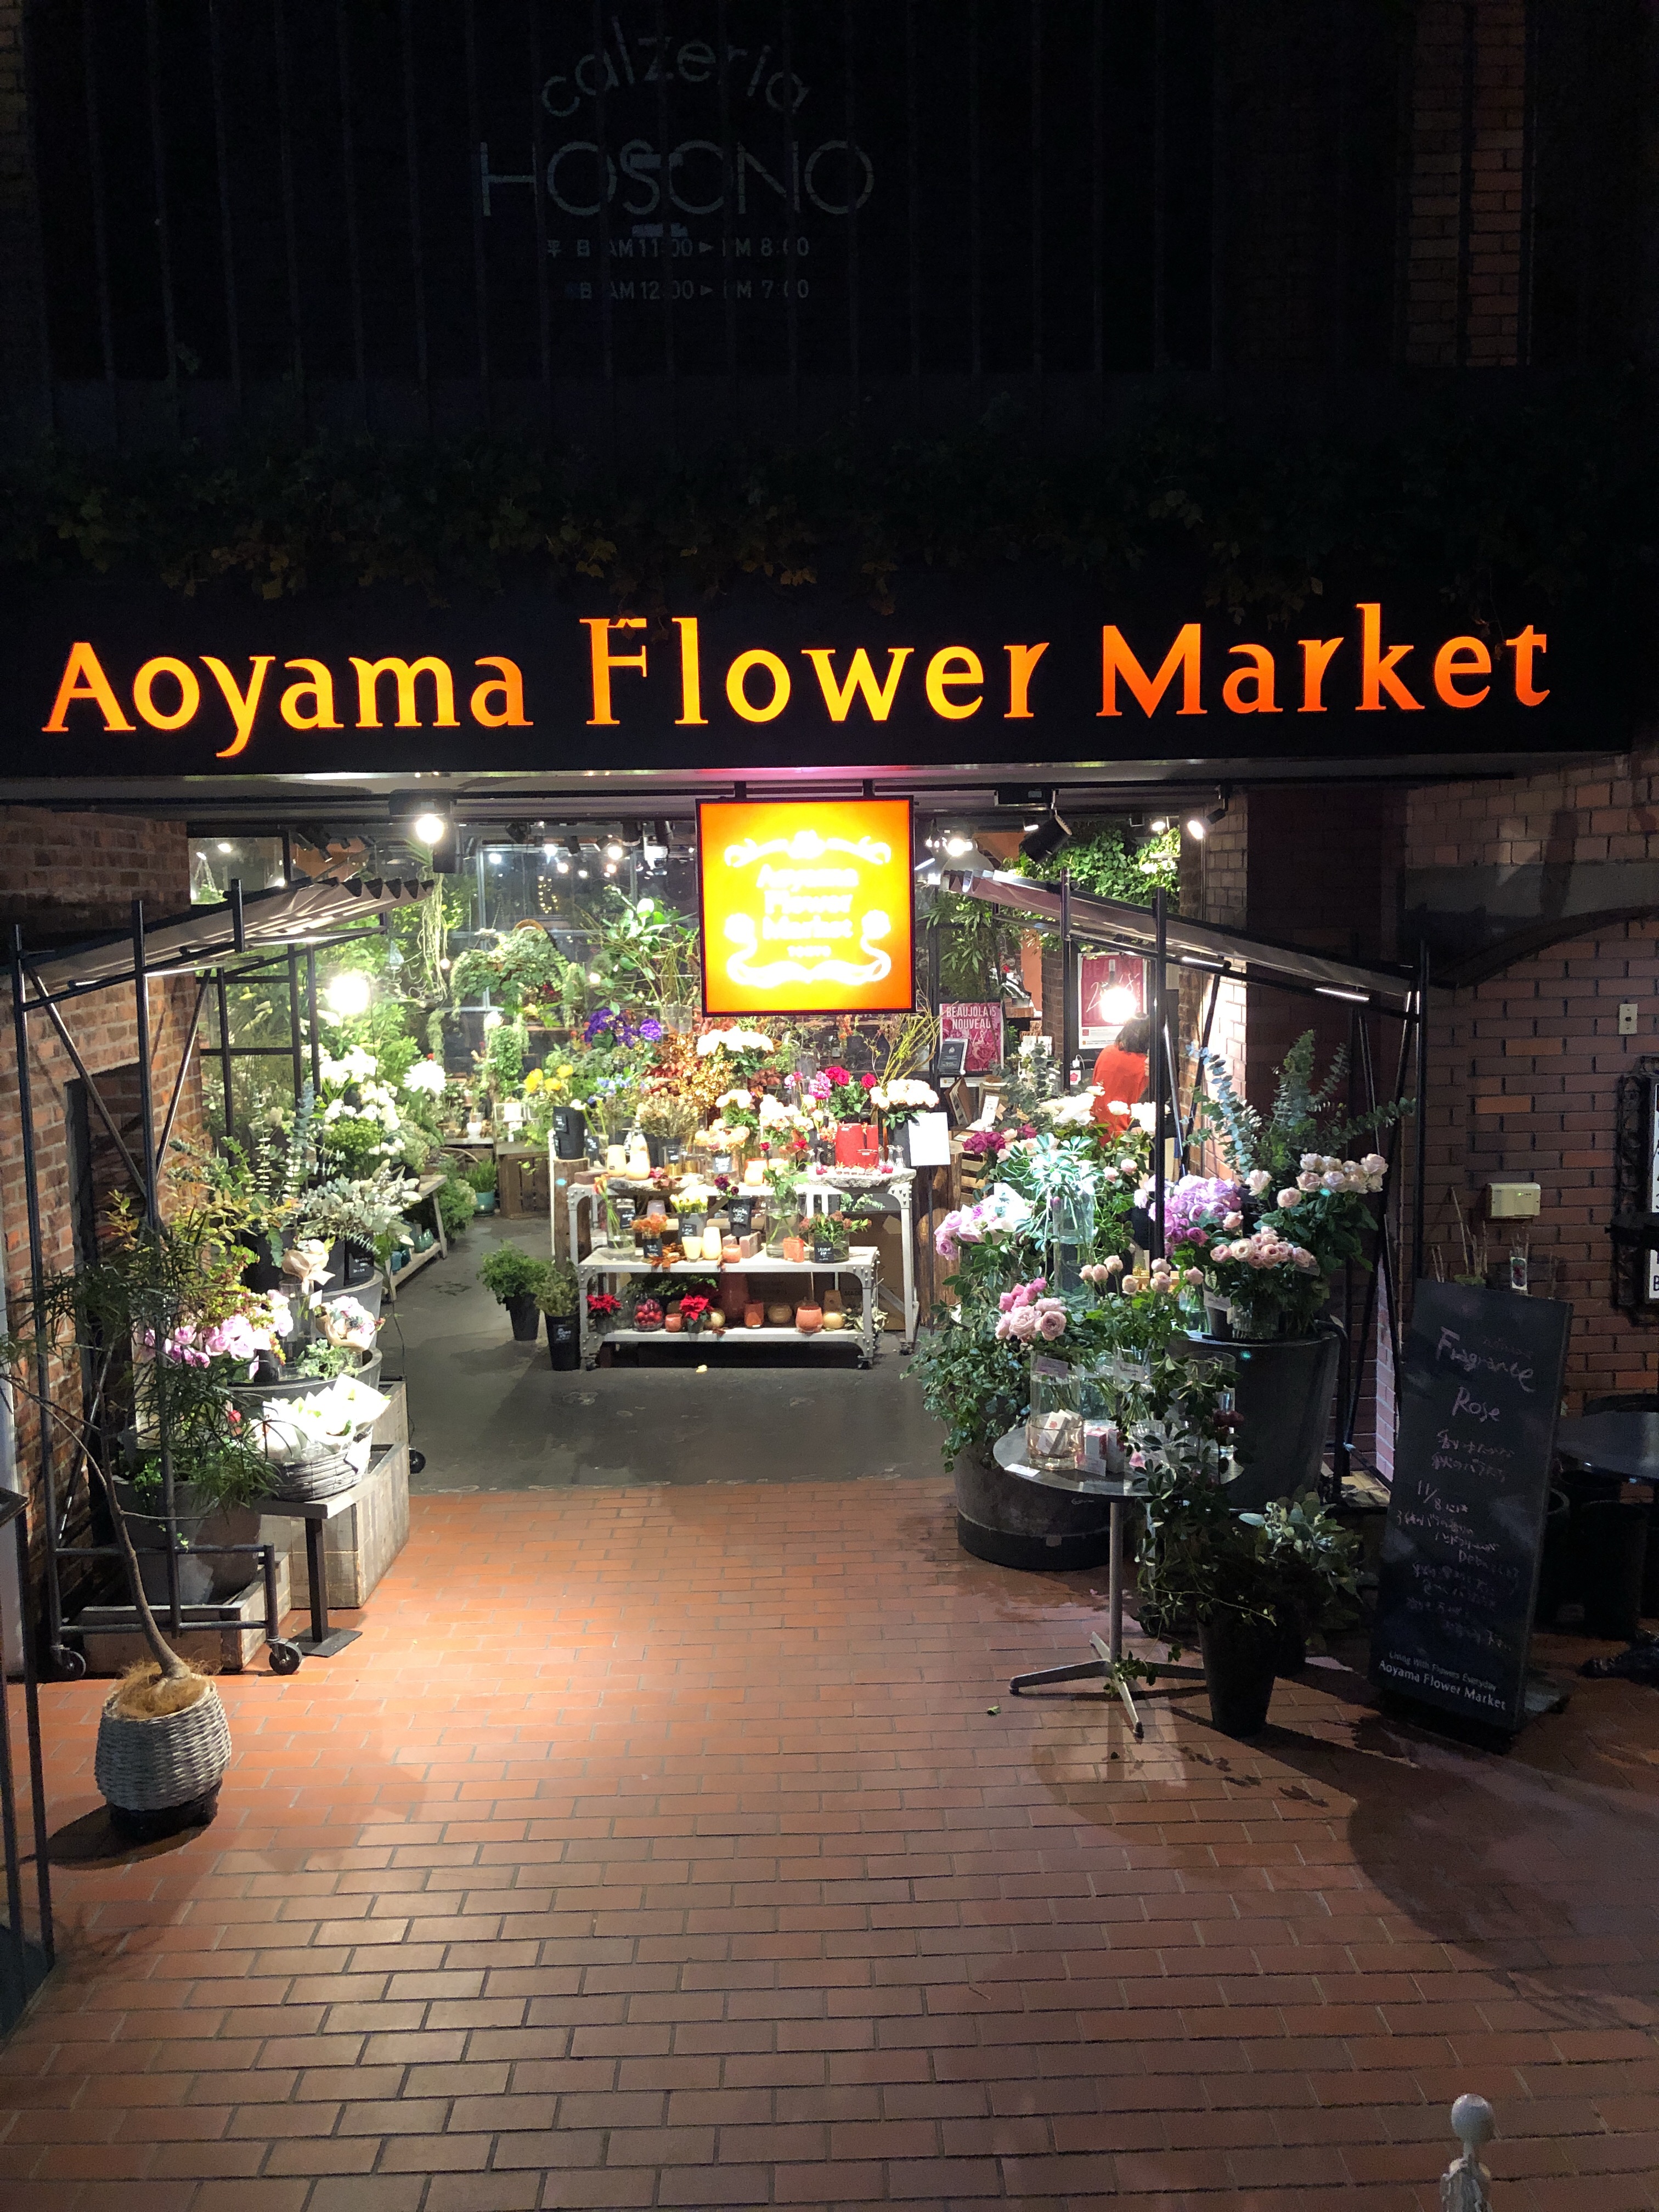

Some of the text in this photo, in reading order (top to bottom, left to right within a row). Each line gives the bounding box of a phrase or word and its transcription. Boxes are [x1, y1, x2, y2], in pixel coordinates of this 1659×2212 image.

[480, 140, 874, 216] HOSONO
[42, 603, 1550, 758] Aoyama Flower Market
[946, 1006, 997, 1018] BEAUJOLAIS
[952, 1018, 991, 1030] NOUVEAU
[1452, 1386, 1500, 1423] Rose
[1378, 1660, 1506, 1711] Aoyama Flower Market
[1389, 1650, 1498, 1692] Living With Flowers Everyday
